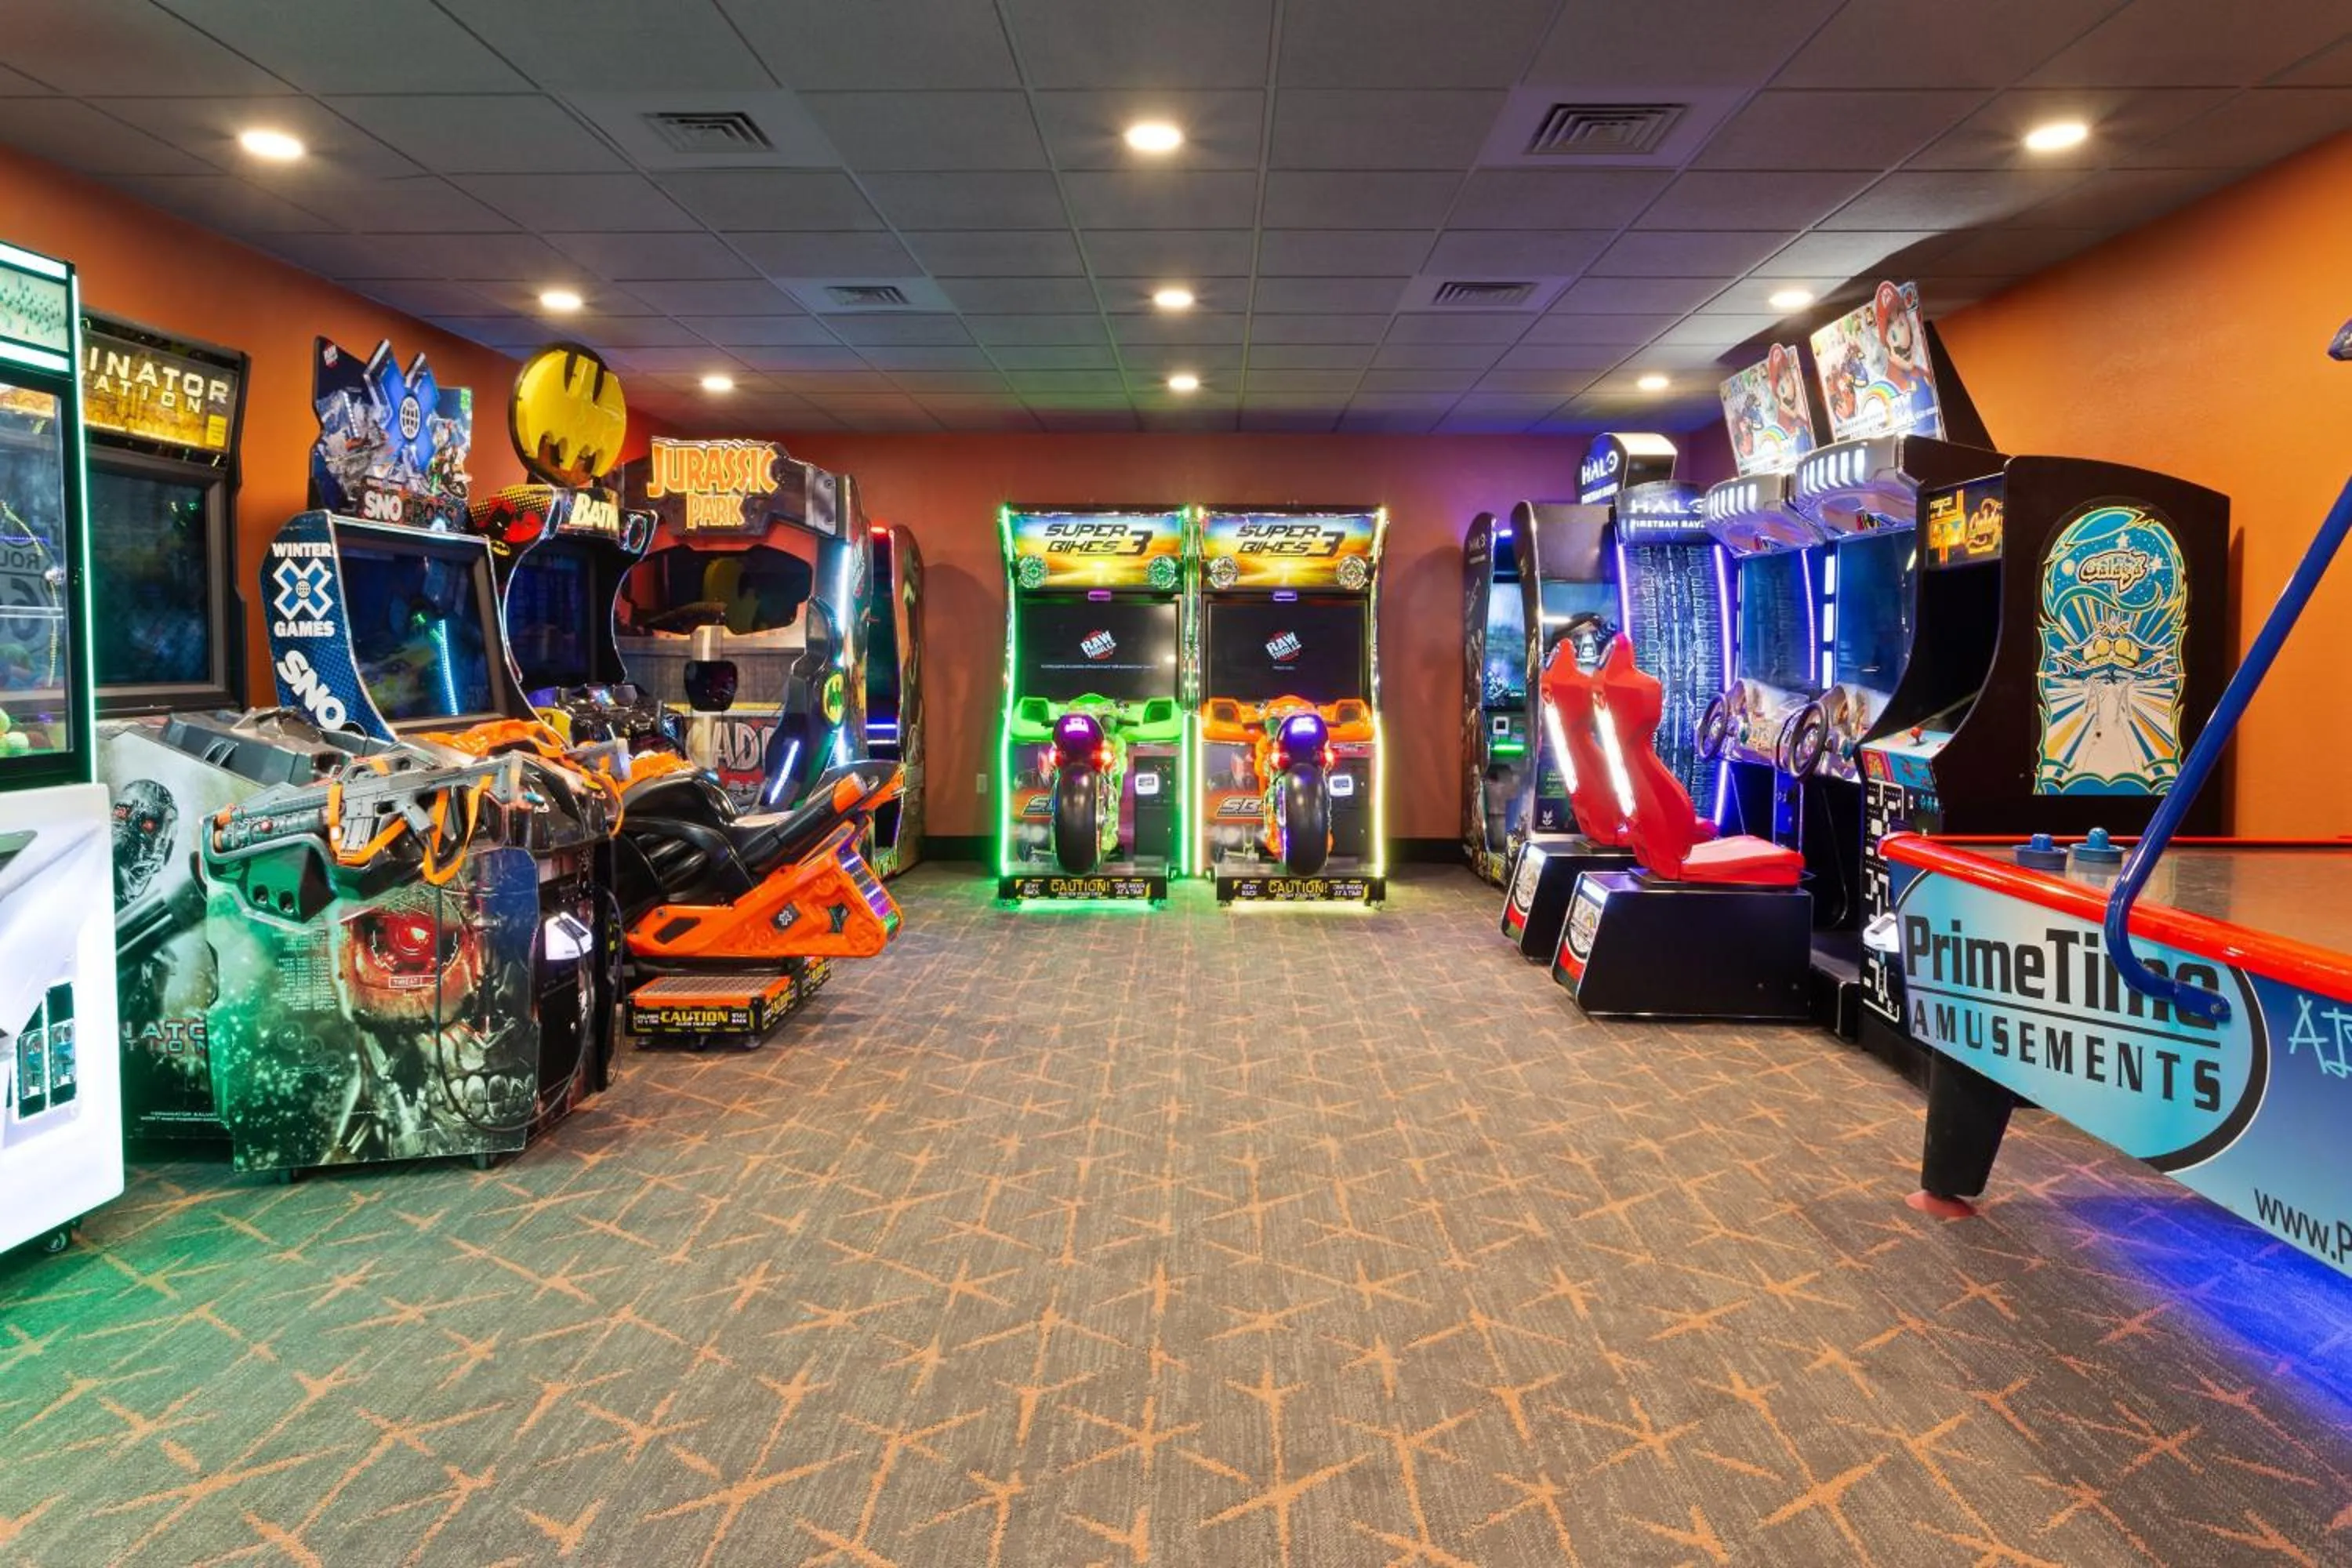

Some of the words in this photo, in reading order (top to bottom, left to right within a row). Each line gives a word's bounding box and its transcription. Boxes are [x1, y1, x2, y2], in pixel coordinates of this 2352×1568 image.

[646, 441, 779, 498] JURASSIC
[1581, 450, 1619, 485] HALO
[686, 492, 746, 529] PARK
[1044, 523, 1129, 537] SUPER
[1046, 539, 1120, 554] BIKES
[1236, 524, 1322, 539] SUPER
[272, 542, 333, 558] WINTER
[1236, 541, 1312, 555] BIKES
[2079, 552, 2147, 593] Galaga
[274, 619, 335, 637] GAMES
[277, 650, 346, 730] SNO
[1905, 915, 2220, 1031] PrimeTime
[1910, 999, 2221, 1113] AMUSEMENTS
